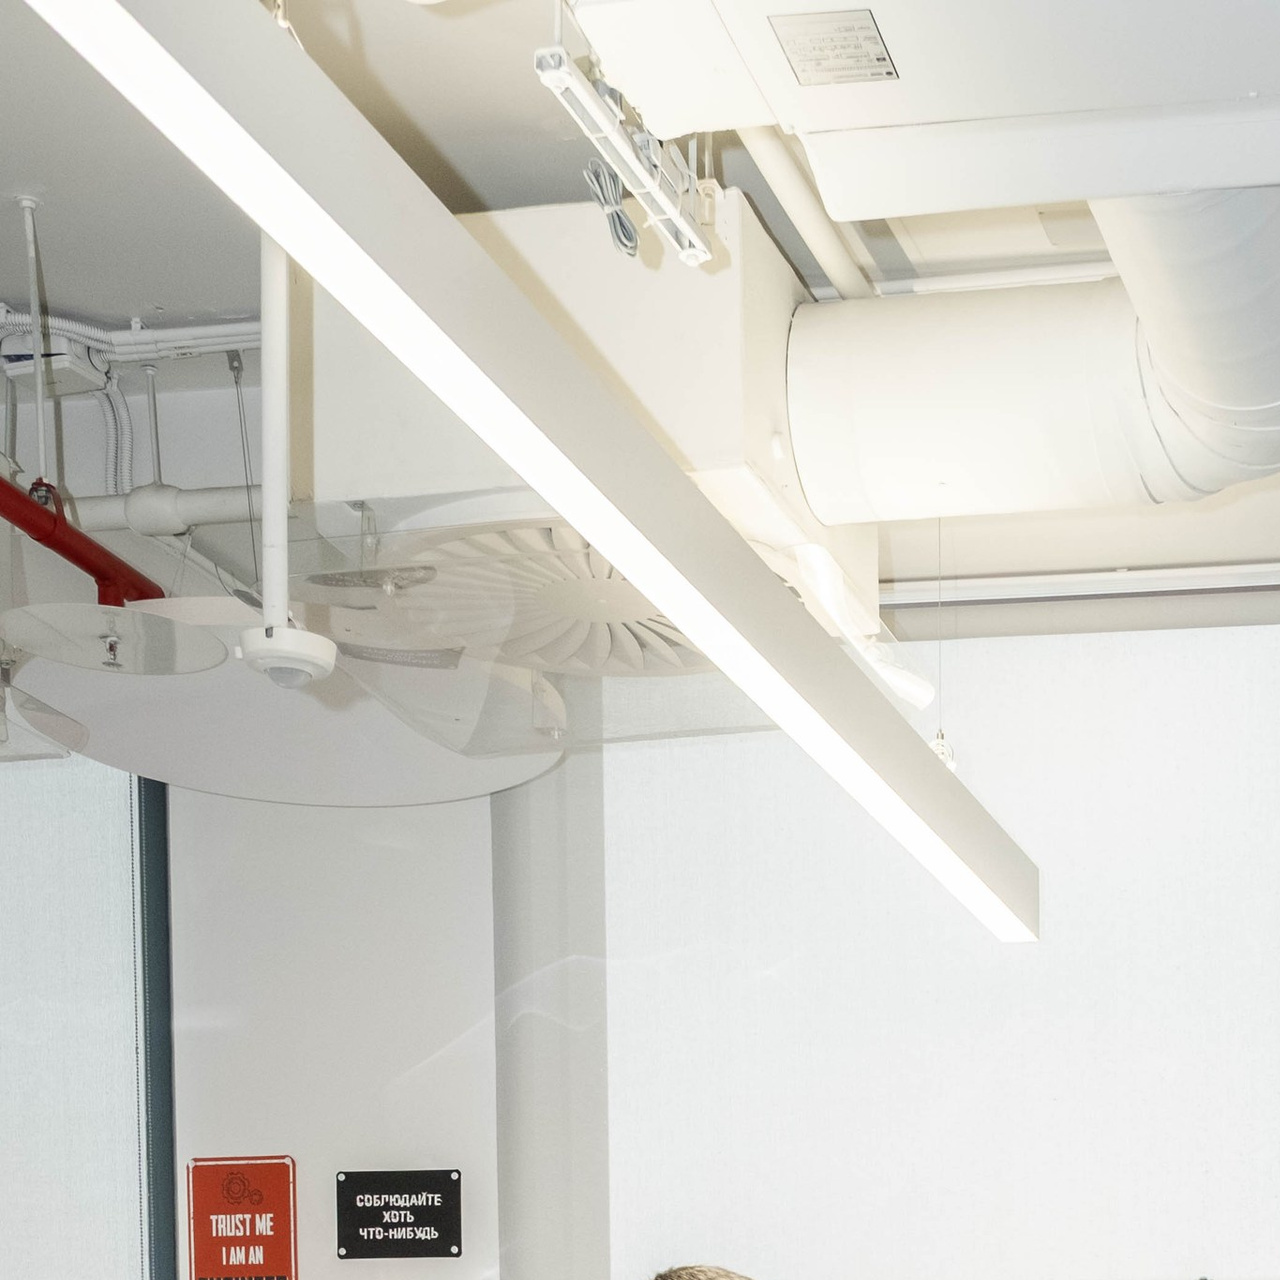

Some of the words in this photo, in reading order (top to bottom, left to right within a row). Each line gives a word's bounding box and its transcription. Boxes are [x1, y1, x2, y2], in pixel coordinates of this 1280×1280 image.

[356, 1191, 443, 1208] СОБЛЮДАЙТЕ
[209, 1213, 252, 1237] TRUST
[255, 1212, 275, 1236] ME
[382, 1210, 415, 1223] ХОТЬ
[359, 1226, 439, 1241] ЧТО-НИБУДЬ
[222, 1246, 227, 1266] I
[229, 1245, 246, 1265] AM
[248, 1245, 264, 1265] AN
